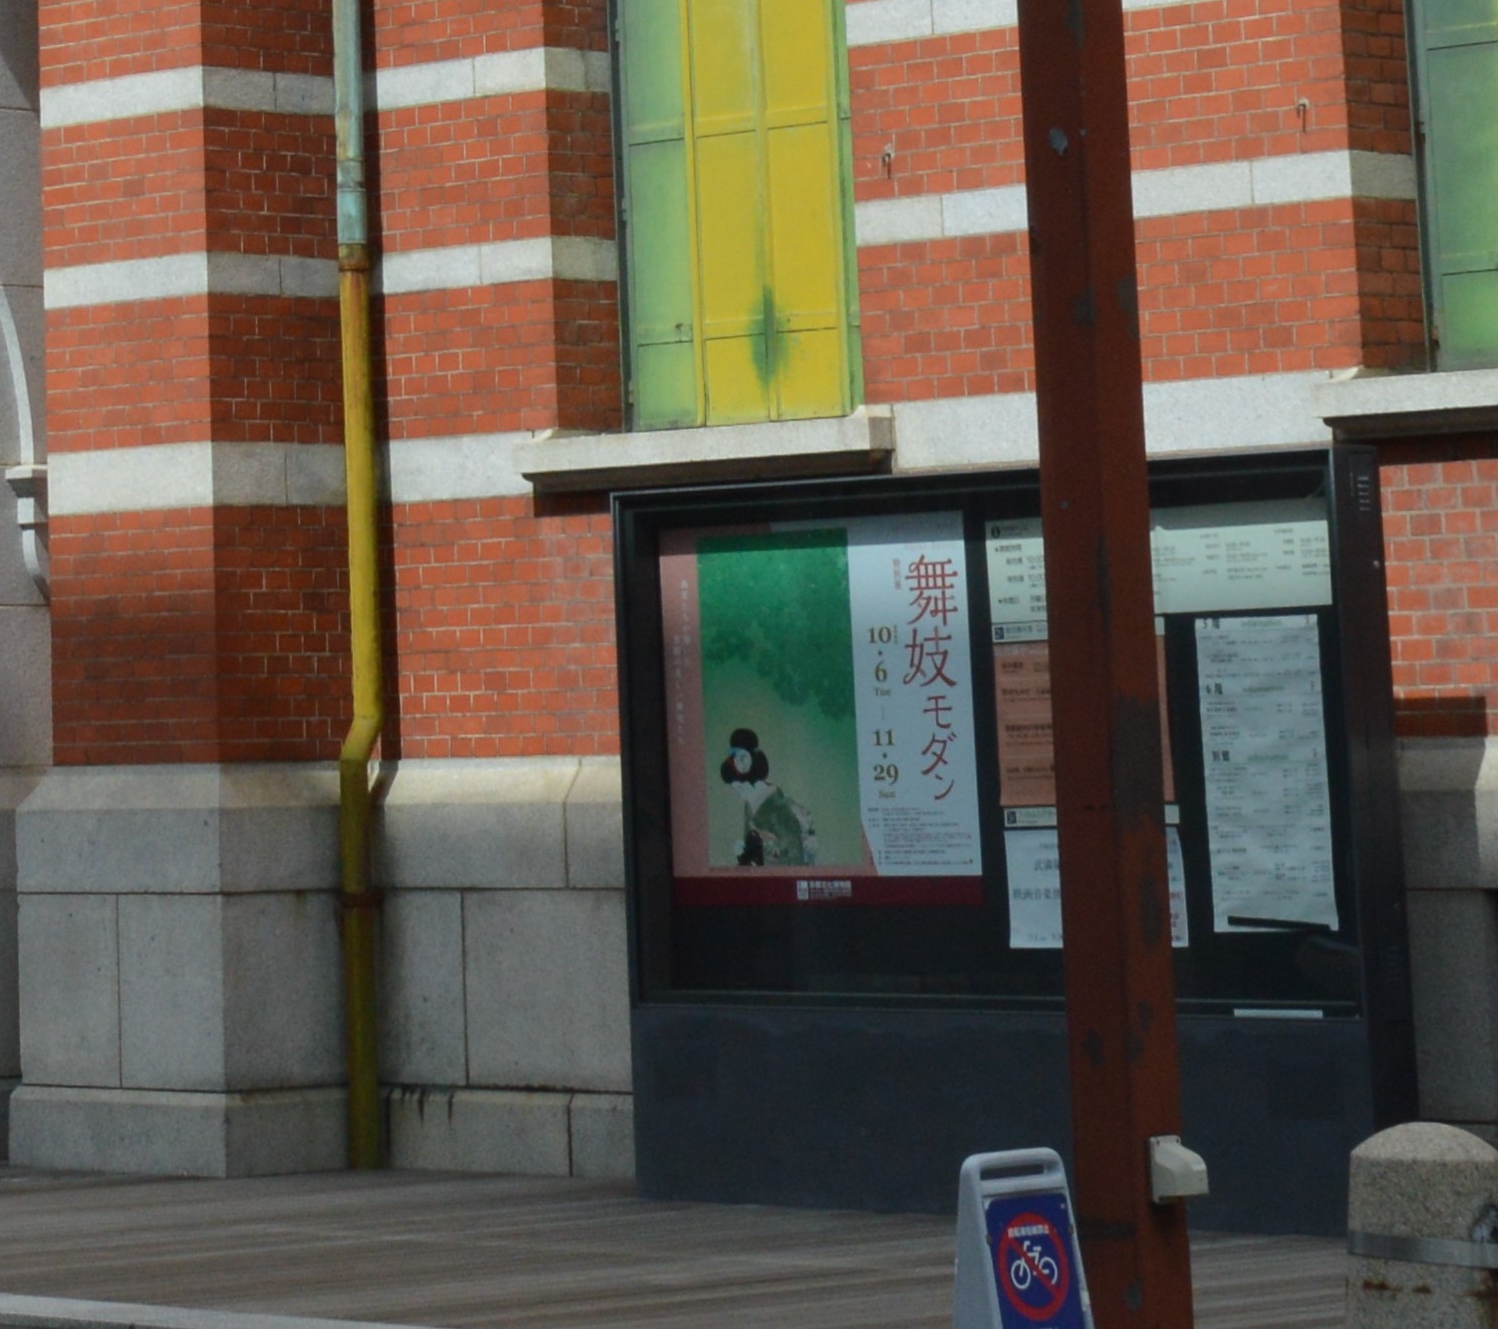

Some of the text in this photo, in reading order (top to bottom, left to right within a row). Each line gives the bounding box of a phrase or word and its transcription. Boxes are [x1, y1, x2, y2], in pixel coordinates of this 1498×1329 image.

[868, 626, 893, 645] 10
[874, 660, 888, 683] 6
[902, 553, 959, 802] 舞妓モダン
[873, 686, 893, 697] Tue
[872, 729, 895, 747] 11
[873, 764, 900, 786] 29
[878, 790, 897, 800] Sun
